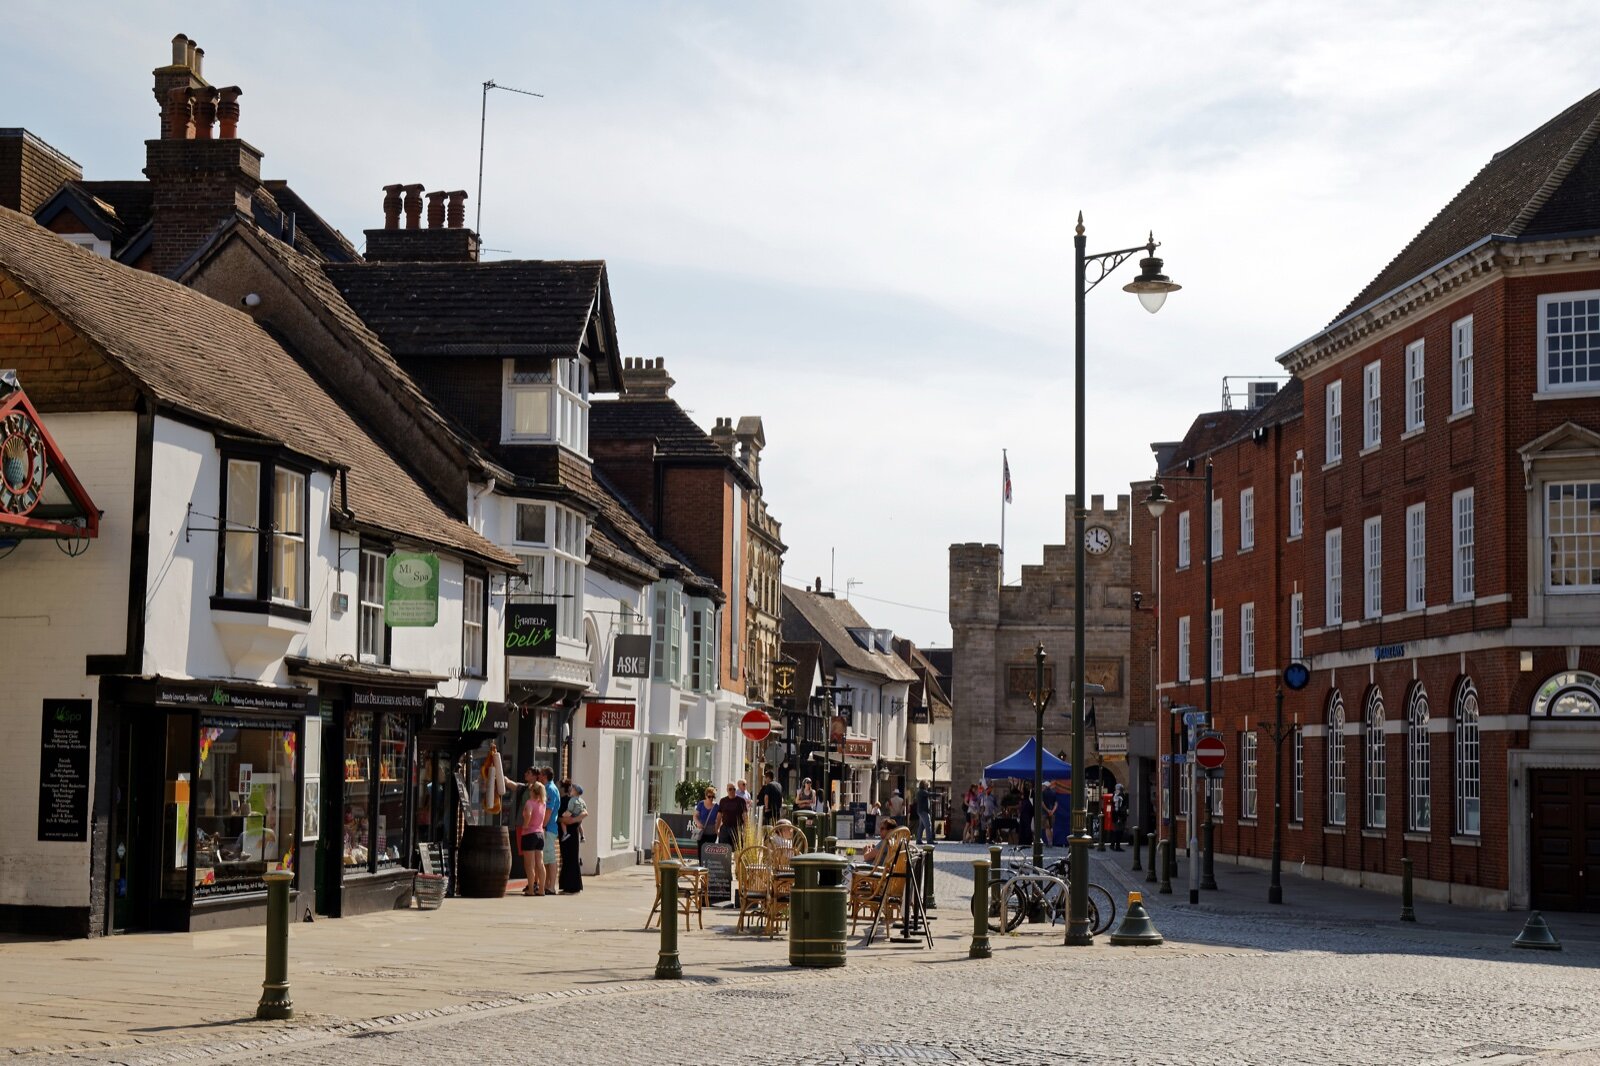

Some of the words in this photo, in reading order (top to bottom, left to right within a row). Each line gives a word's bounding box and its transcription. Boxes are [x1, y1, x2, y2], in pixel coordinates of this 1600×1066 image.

[400, 564, 411, 574] Mi
[413, 571, 428, 582] Spa
[506, 628, 544, 648] Deli
[617, 656, 638, 674] ASK
[199, 694, 208, 702] Clinic
[354, 692, 369, 704] ITALIAN
[370, 691, 395, 705] DELICATESSEN
[402, 696, 411, 706] FINE
[411, 696, 423, 706] WINES
[275, 700, 288, 709] Academy
[602, 711, 632, 720] STRUTT
